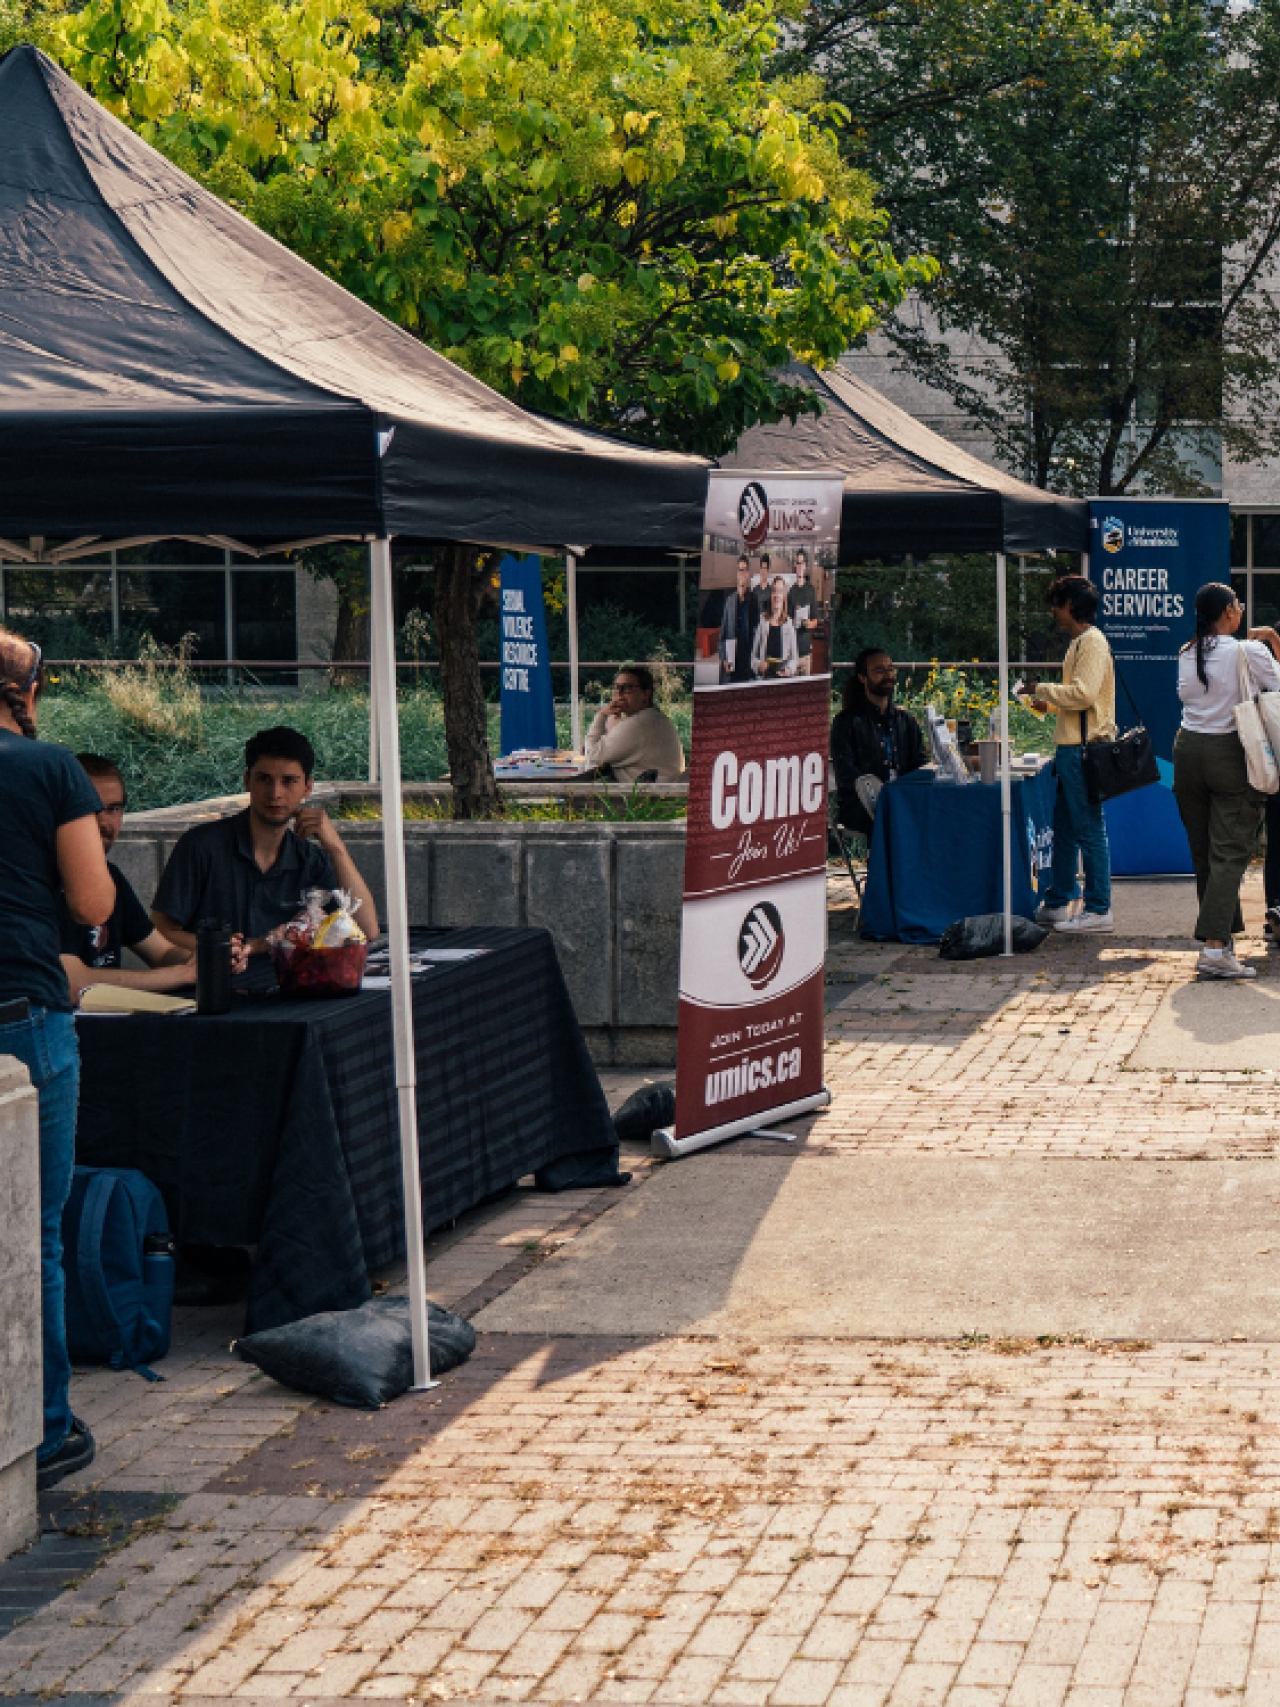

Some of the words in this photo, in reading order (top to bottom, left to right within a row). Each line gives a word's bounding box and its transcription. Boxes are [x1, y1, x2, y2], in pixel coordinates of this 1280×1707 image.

[772, 509, 816, 531] UMICS
[1127, 525, 1179, 538] University
[1103, 567, 1169, 591] CAREER
[1103, 593, 1184, 618] SERVICES
[502, 616, 535, 640] VIOLENCE
[502, 641, 539, 668] RESOURCE
[503, 666, 531, 693] CENTRE
[710, 750, 823, 831] Come
[727, 828, 768, 880] Join
[773, 819, 808, 858] Us!
[704, 1046, 802, 1107] umics.ca
